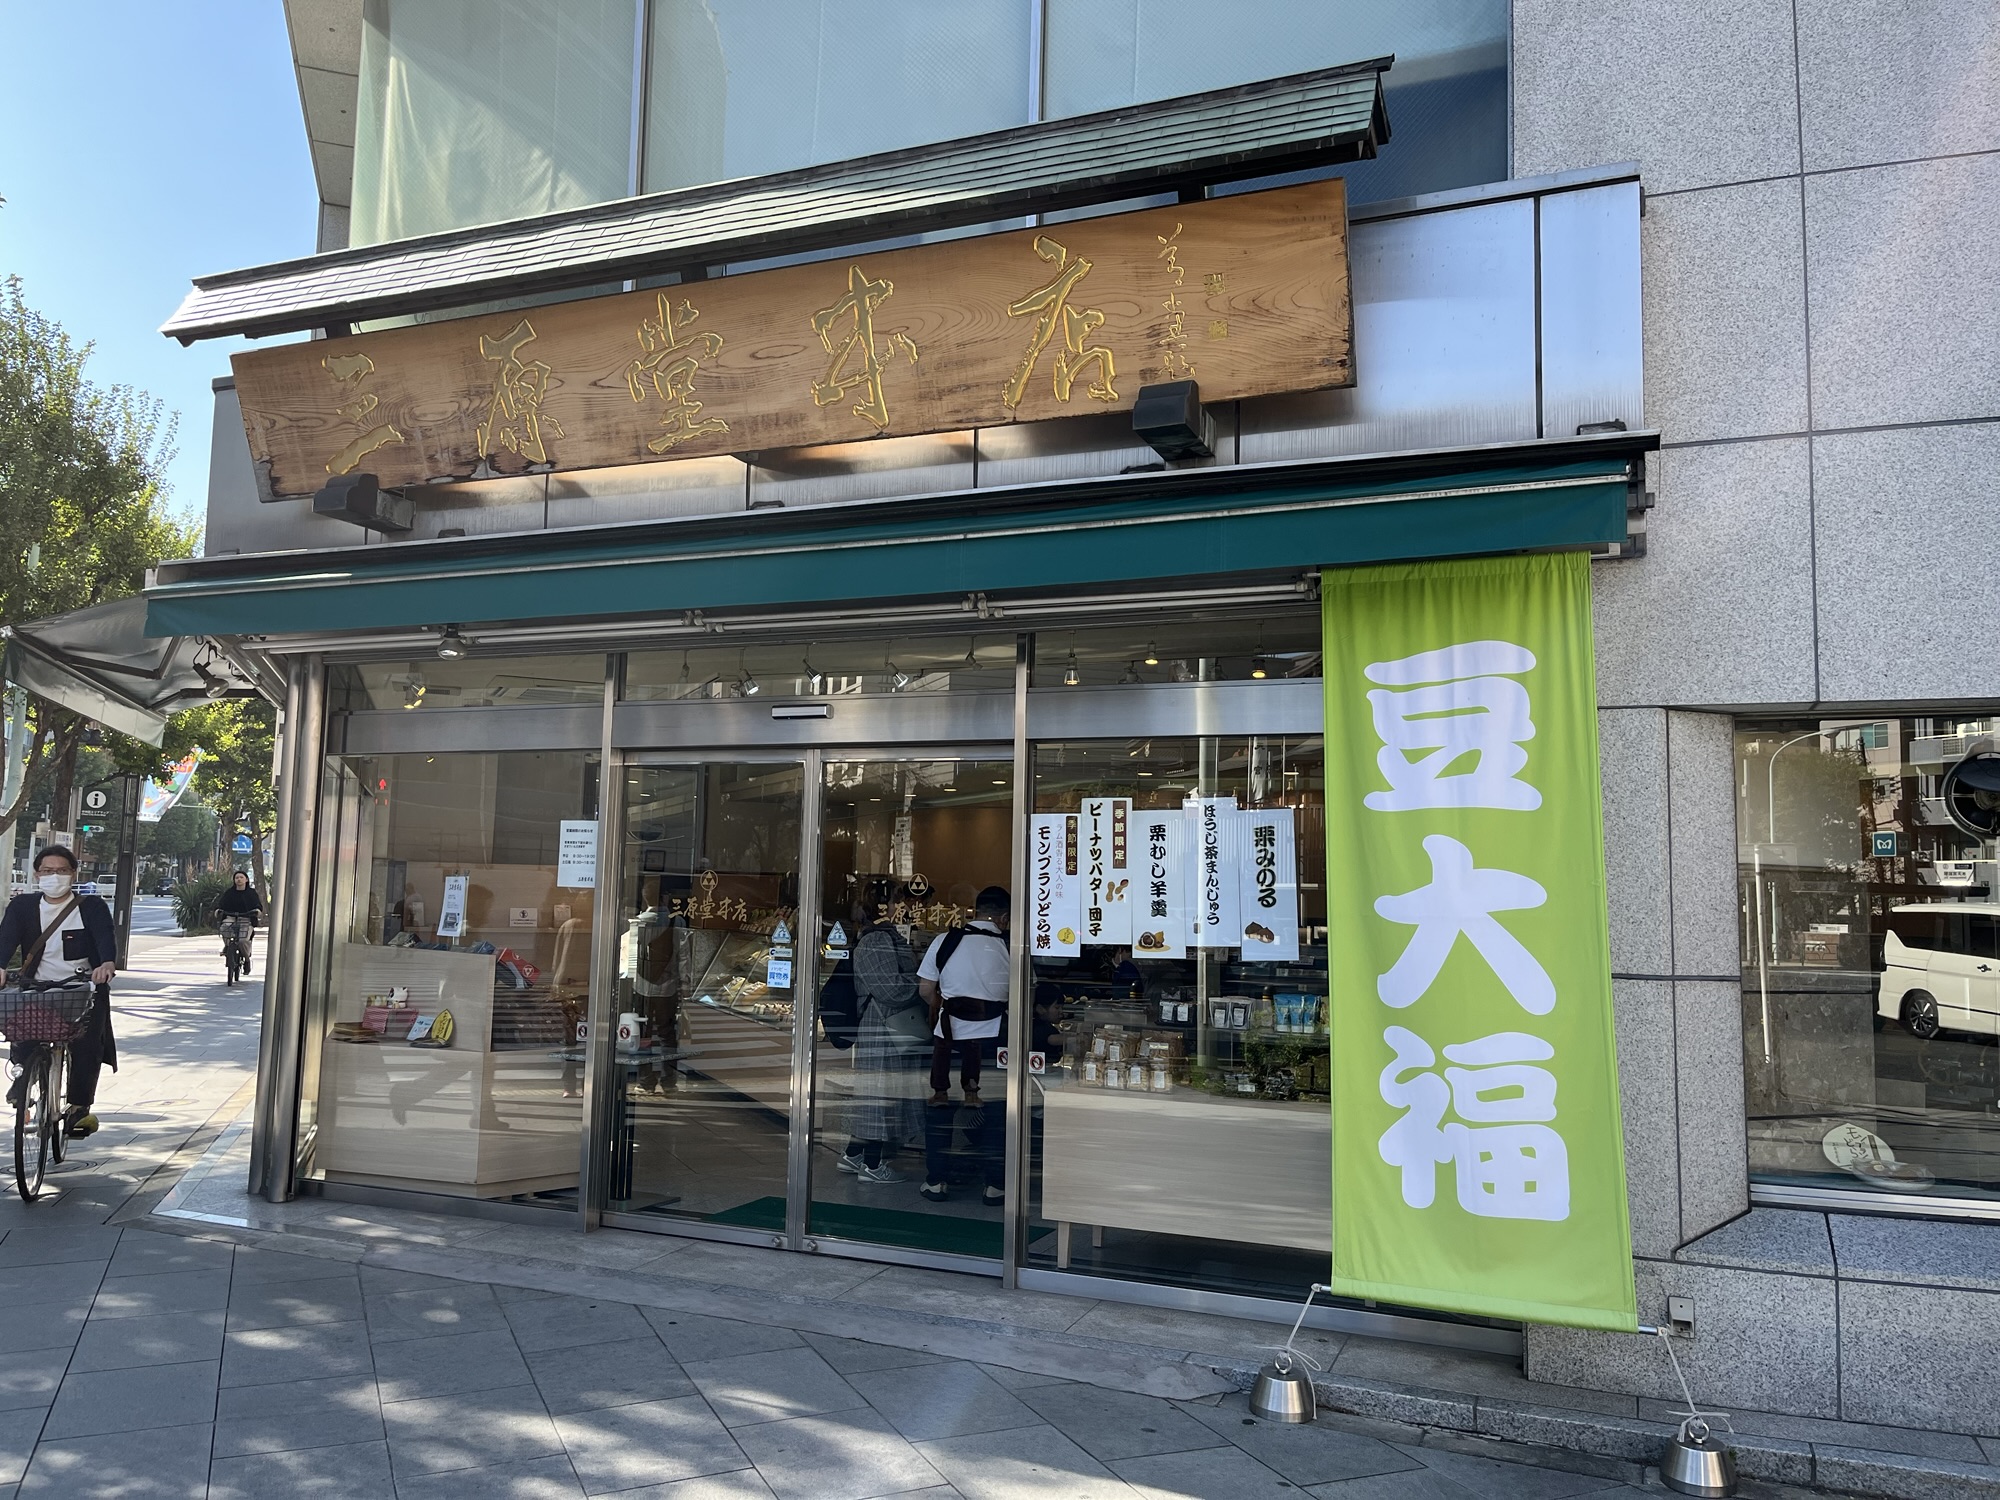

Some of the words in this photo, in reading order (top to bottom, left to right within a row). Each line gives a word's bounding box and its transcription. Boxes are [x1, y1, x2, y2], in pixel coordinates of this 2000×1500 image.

[321, 233, 1120, 475] 三原堂本店
[1067, 818, 1077, 871] 季節限定
[1114, 808, 1125, 861] 季節限定
[1149, 824, 1168, 918] 栗むし羊羹
[1204, 804, 1220, 926] ほうじ茶まんじゅう
[1254, 825, 1277, 908] 栗みのる
[668, 896, 749, 922] 三原堂本店
[873, 901, 962, 929] 三原堂本店
[1036, 825, 1052, 950] モンブランどら焼
[1363, 640, 1569, 1222] 豆大福
